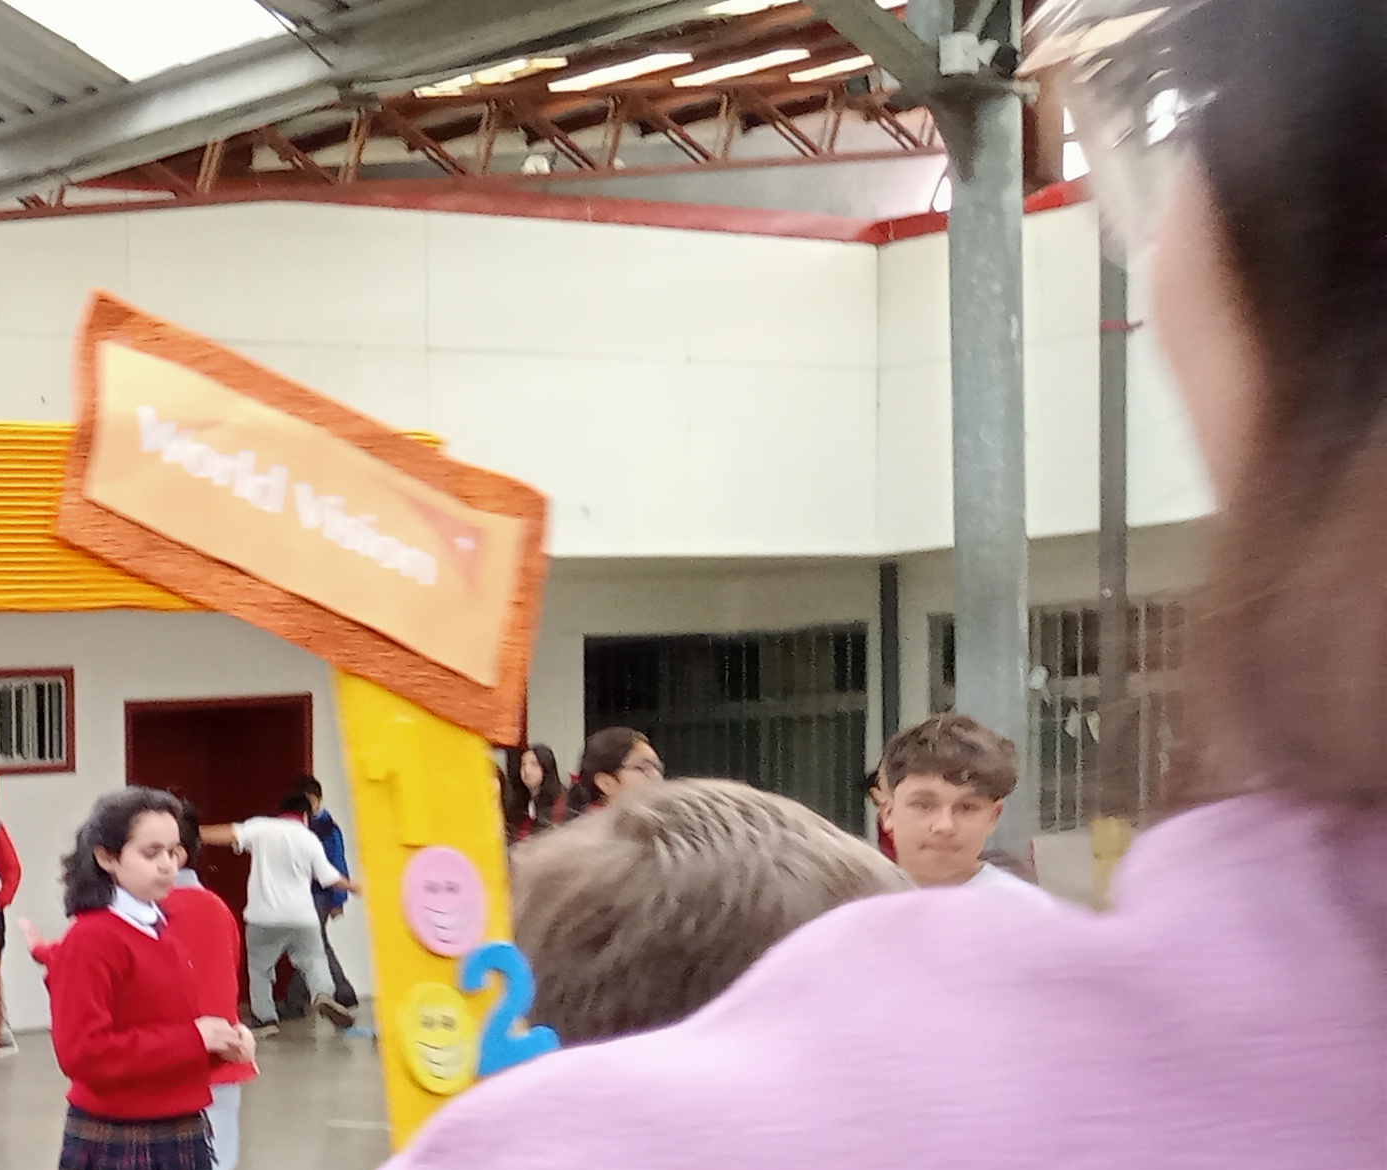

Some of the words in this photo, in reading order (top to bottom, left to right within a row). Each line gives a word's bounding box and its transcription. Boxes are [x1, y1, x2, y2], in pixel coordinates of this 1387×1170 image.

[137, 405, 289, 513] World
[293, 482, 438, 587] Vision
[459, 941, 562, 1077] 2
